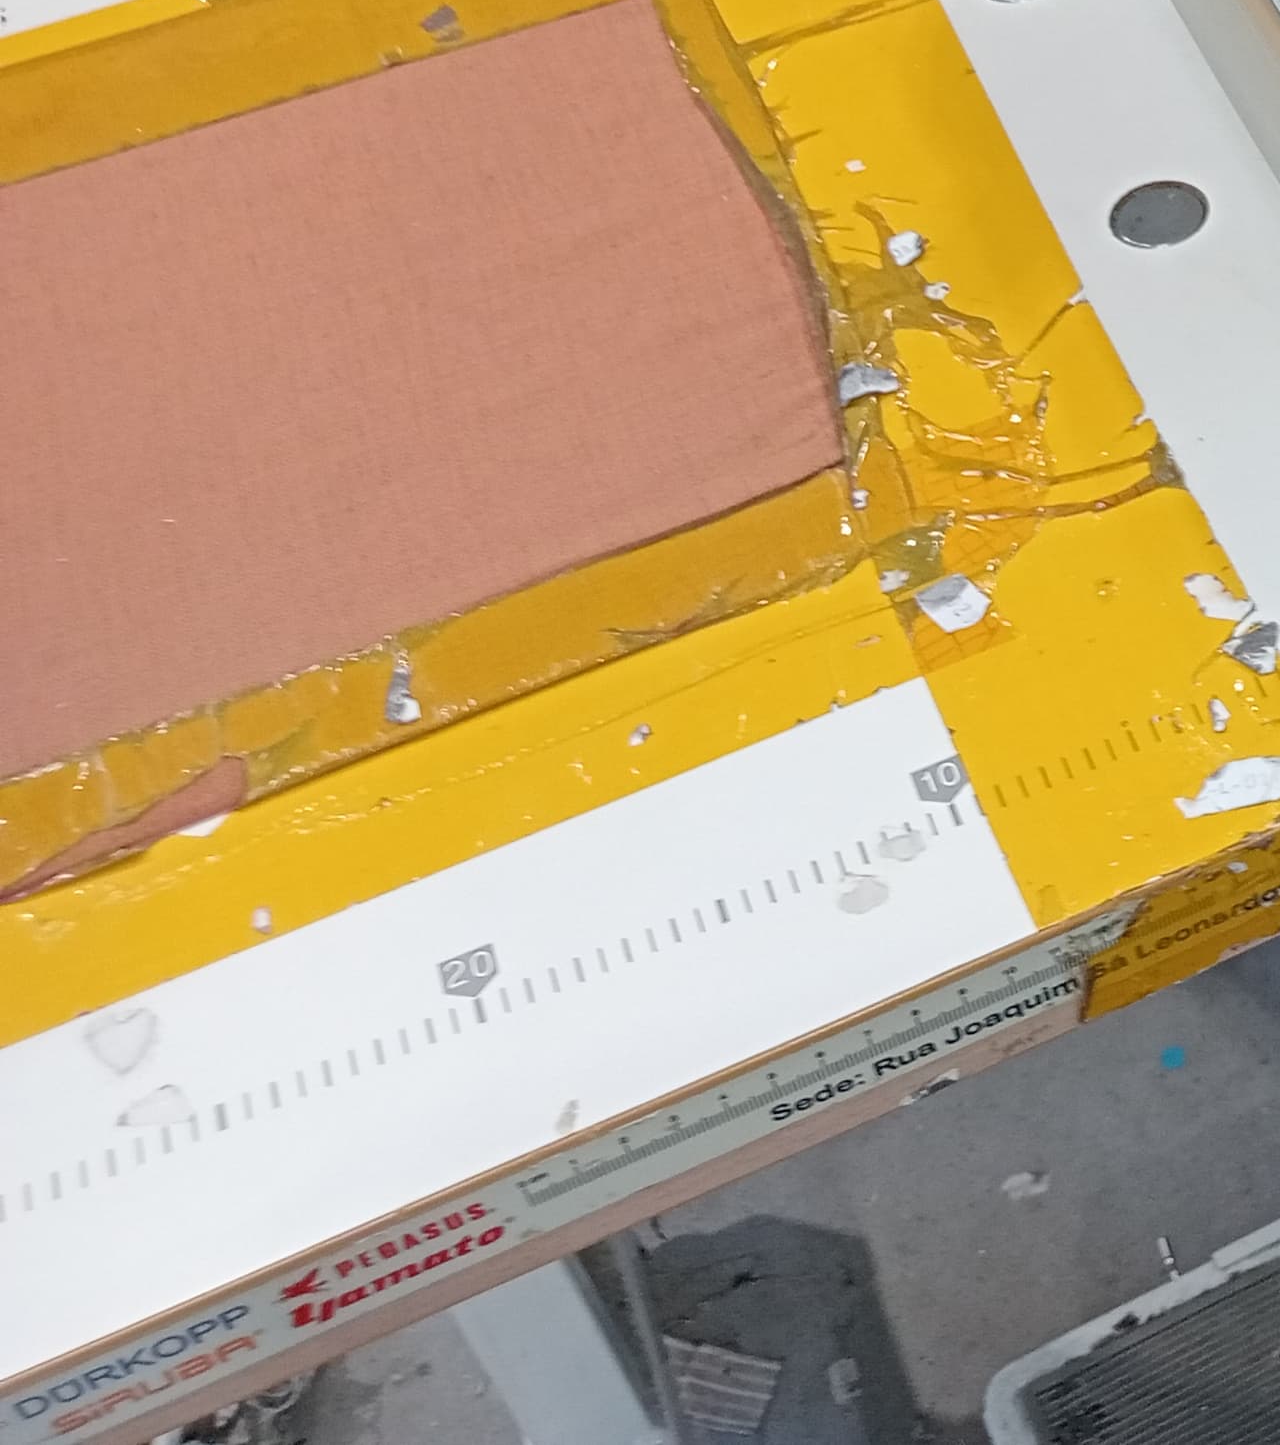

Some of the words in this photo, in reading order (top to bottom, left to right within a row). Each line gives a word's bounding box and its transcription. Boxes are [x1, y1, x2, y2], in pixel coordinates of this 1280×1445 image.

[918, 761, 961, 794] 10
[442, 949, 496, 990] 20
[771, 1070, 864, 1122] Sede:
[872, 1040, 937, 1077] Rua
[944, 974, 1079, 1045] Joaquim
[1134, 888, 1278, 960] Leonardo
